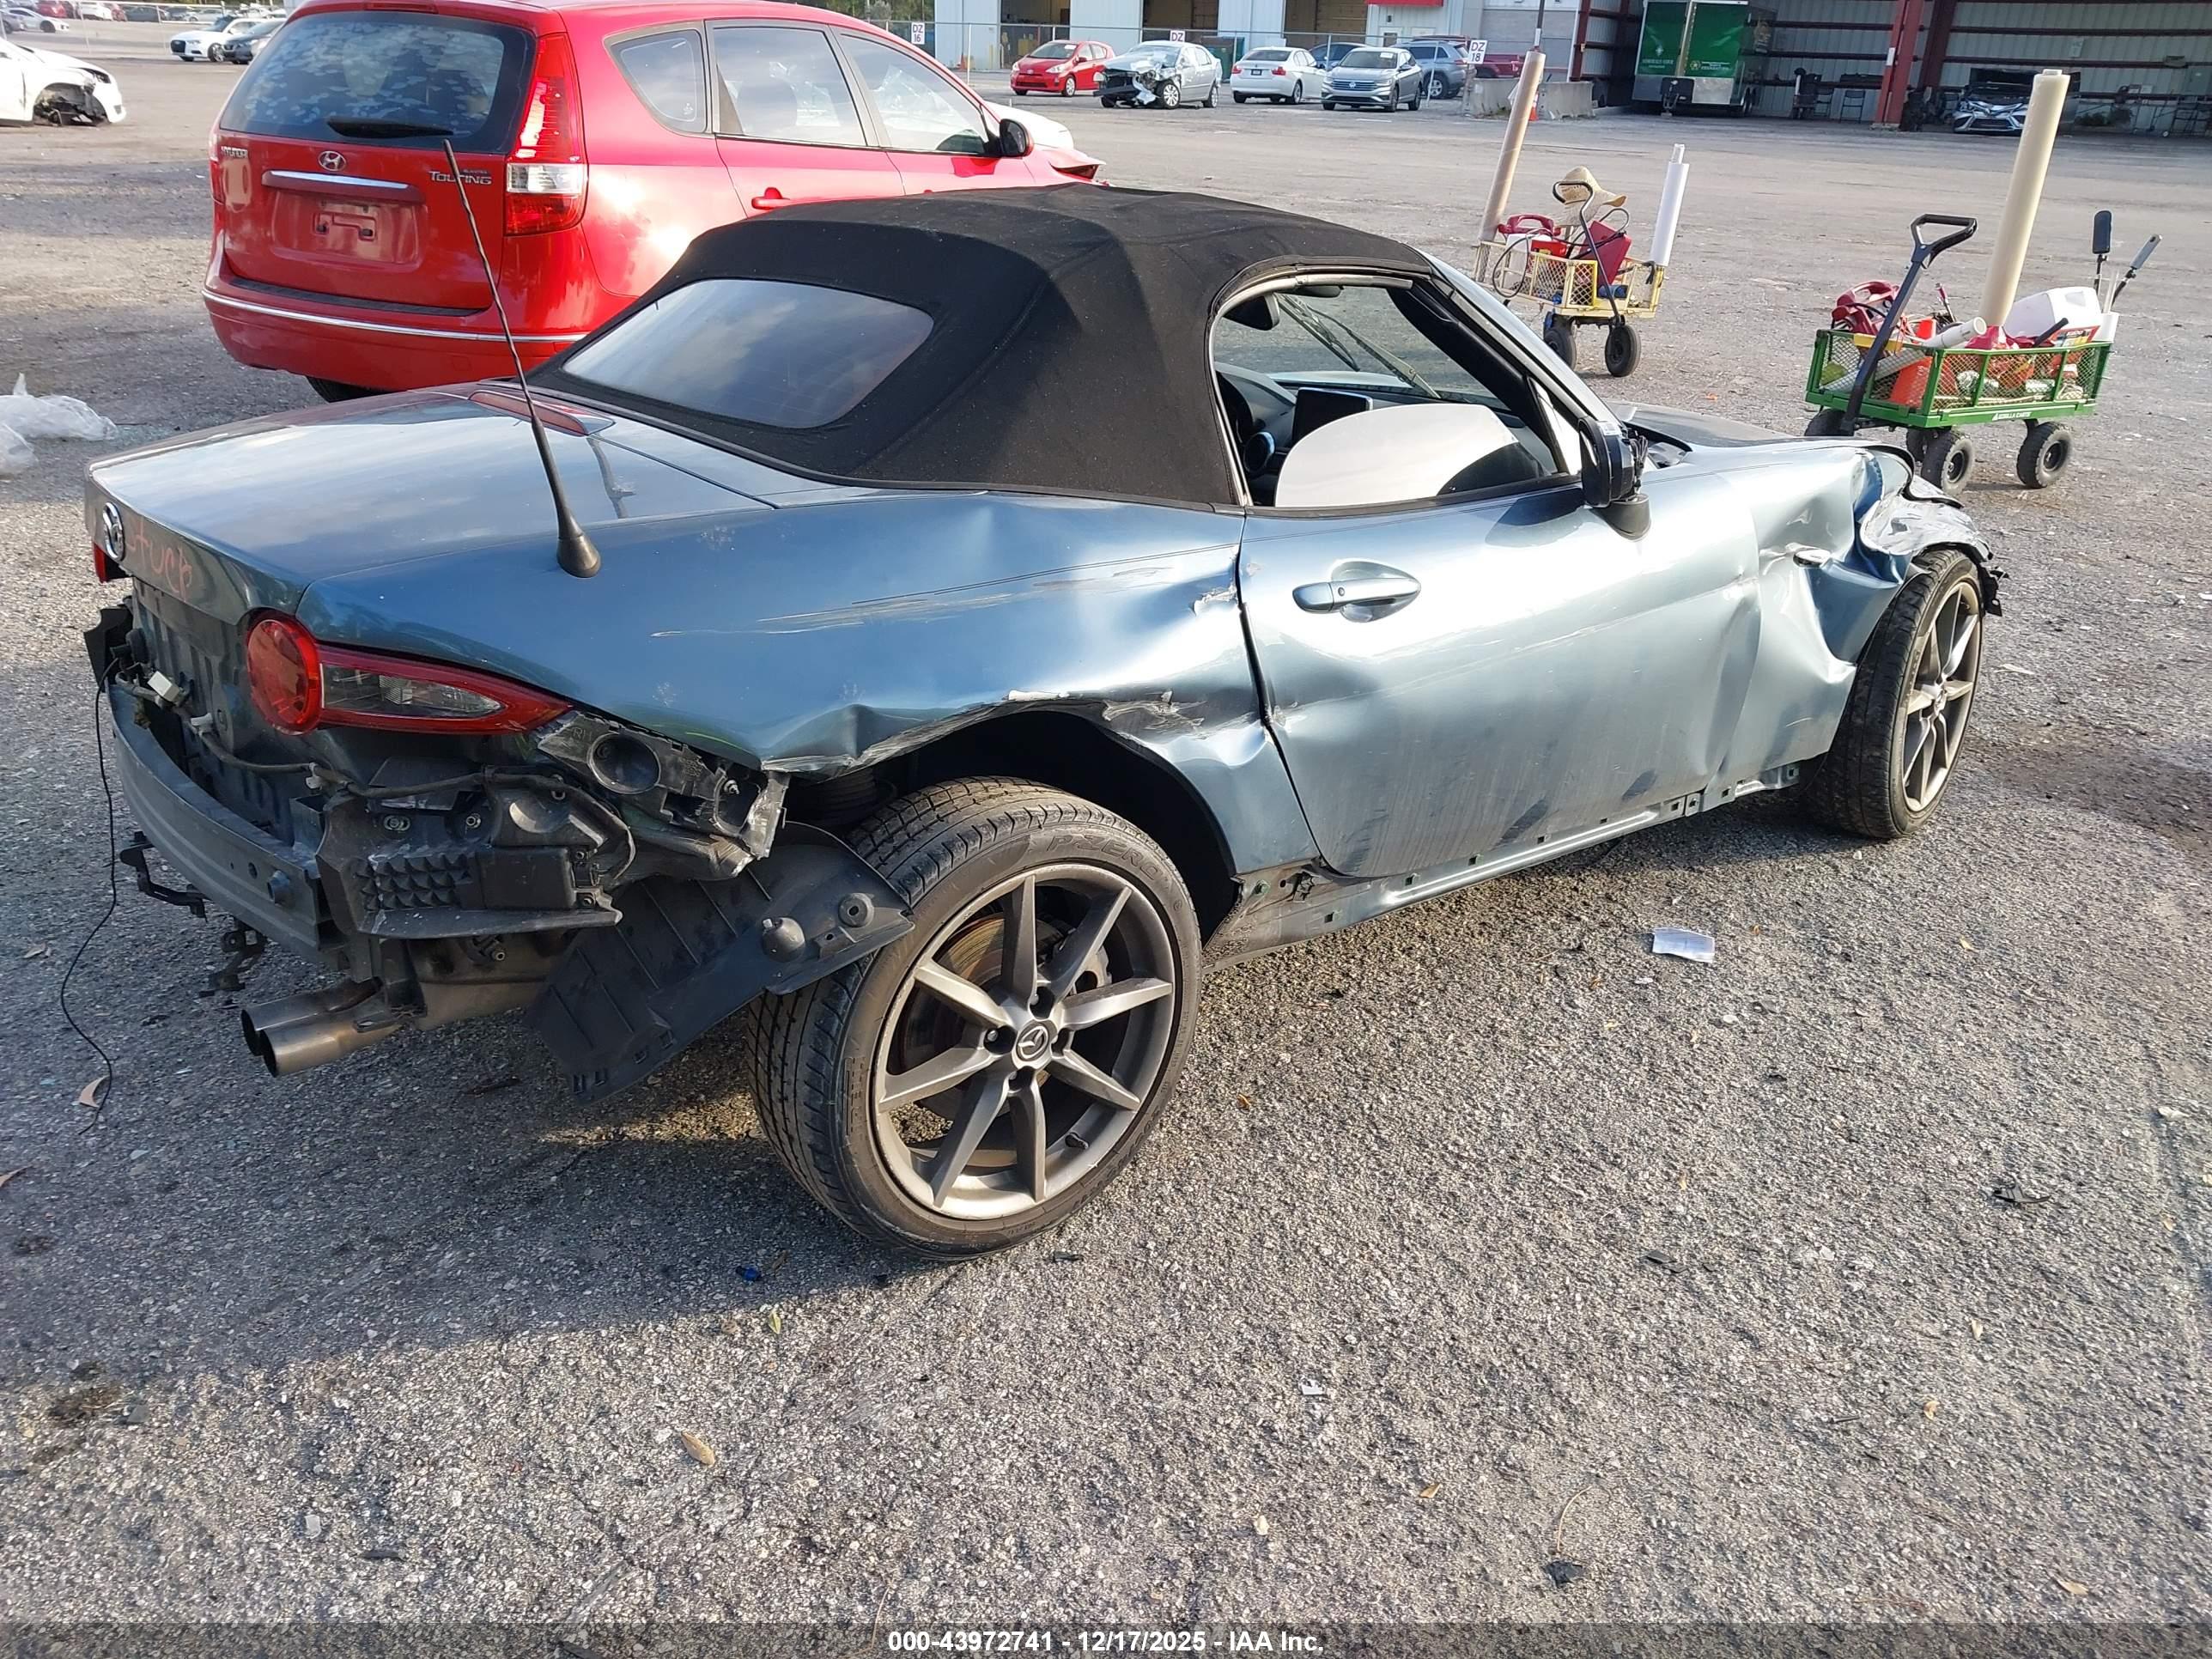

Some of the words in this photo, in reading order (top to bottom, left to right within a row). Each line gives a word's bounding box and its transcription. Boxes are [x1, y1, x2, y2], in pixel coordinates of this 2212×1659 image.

[913, 24, 924, 33] DZ
[1171, 32, 1184, 41] DZ
[1471, 42, 1486, 52] DZ
[1471, 52, 1481, 62] 18
